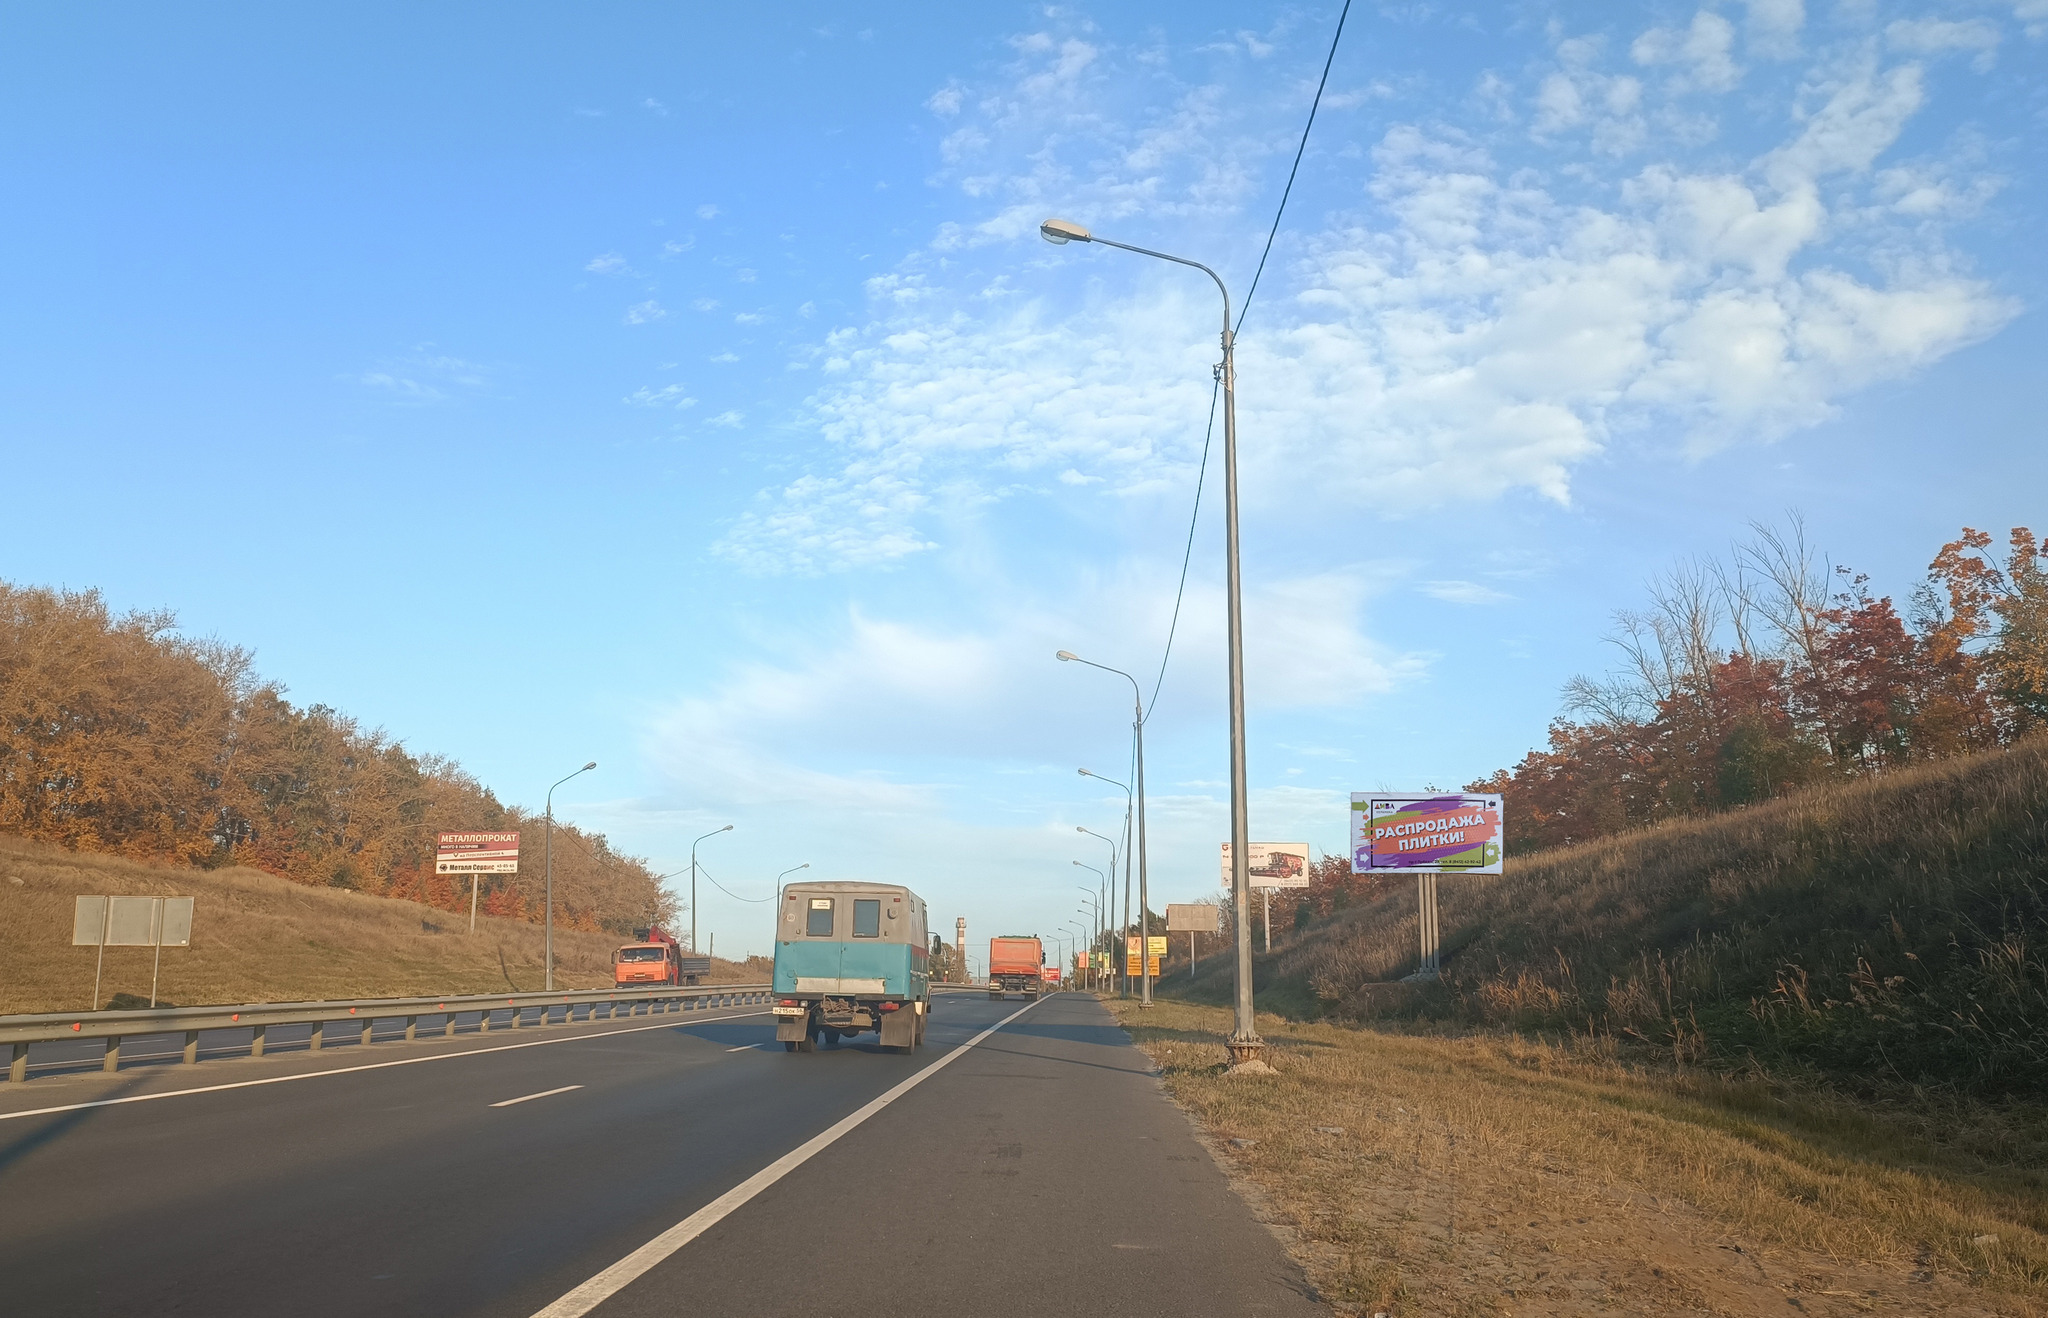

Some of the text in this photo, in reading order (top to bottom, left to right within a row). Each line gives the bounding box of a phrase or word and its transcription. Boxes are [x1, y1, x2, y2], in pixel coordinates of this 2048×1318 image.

[1375, 814, 1485, 839] РАСПРОДАЖА
[441, 834, 517, 842] МЕТАЛЛОПРОКАТ
[1399, 831, 1465, 851] ПЛИТКИ!
